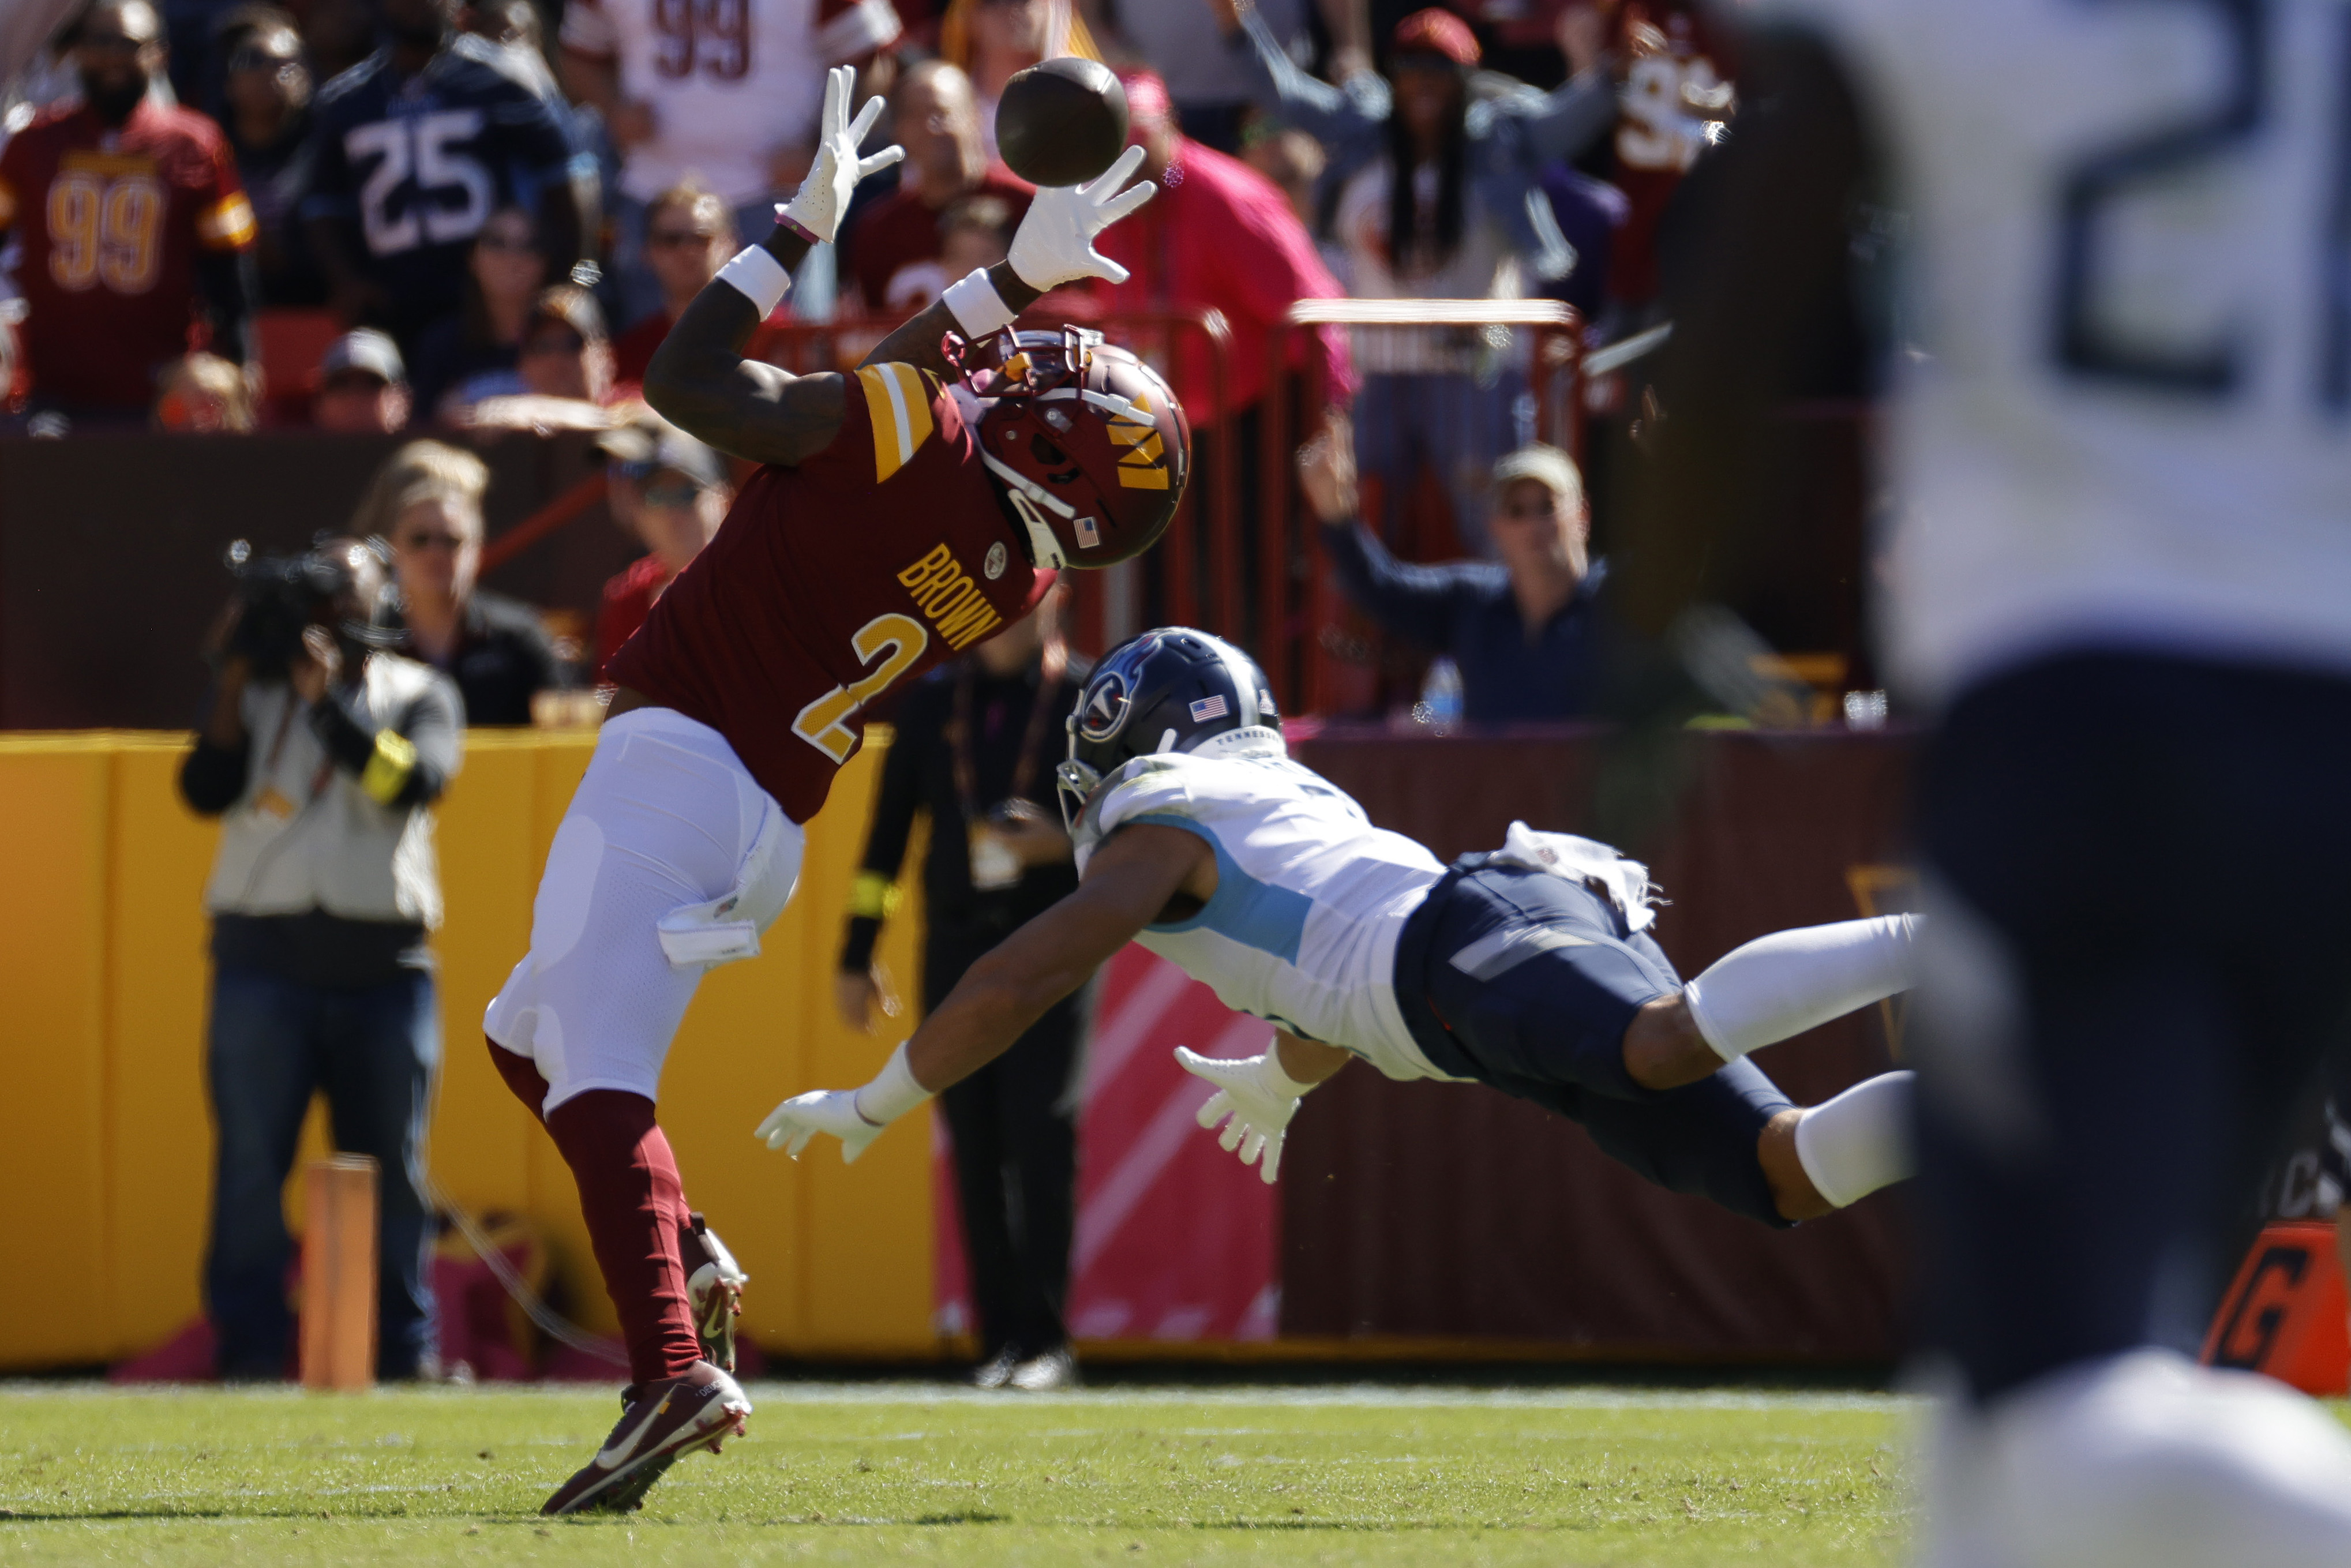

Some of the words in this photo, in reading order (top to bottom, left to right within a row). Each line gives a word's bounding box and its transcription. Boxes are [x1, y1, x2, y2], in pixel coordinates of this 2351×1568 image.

[46, 172, 165, 292] 99
[345, 110, 493, 255] 25
[897, 542, 1003, 651] BROWN
[791, 613, 928, 765] 2
